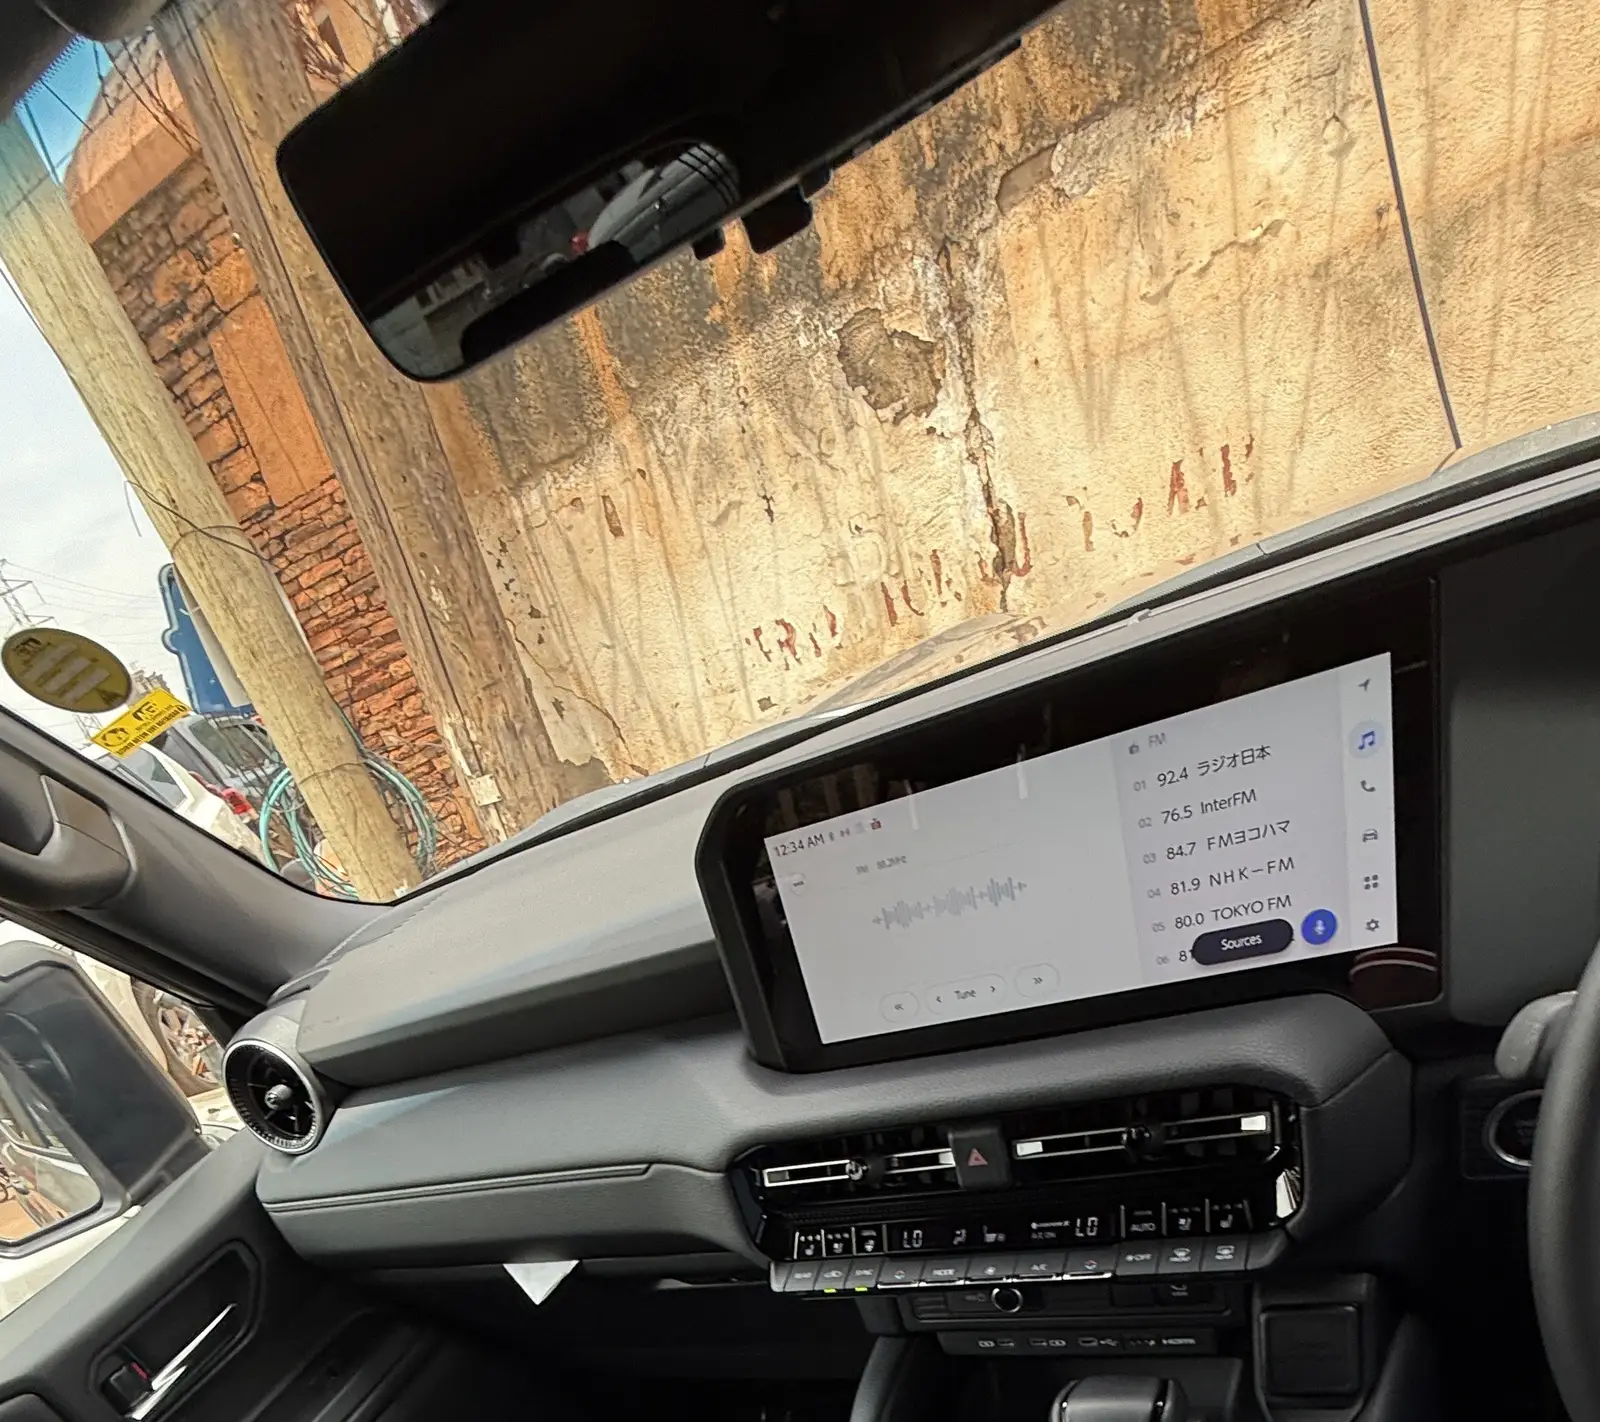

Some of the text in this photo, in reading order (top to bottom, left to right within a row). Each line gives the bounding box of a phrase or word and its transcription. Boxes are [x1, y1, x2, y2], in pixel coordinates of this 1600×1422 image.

[1148, 732, 1168, 748] FM
[1133, 744, 1273, 792] 01 92.4 ラジオ日本
[1138, 788, 1258, 829] 02 76.5 InterFM
[774, 832, 826, 858] 12:34 AM
[1142, 820, 1292, 865] 03 84.7 FMヨコハマ
[1147, 887, 1161, 900] 04
[1170, 877, 1202, 897] 81.9
[1152, 894, 1293, 934] 05 80.0 TOKYO FM
[1220, 933, 1263, 952] Sources
[953, 986, 977, 1002] Tune
[1130, 1221, 1156, 1233] AUTO
[1135, 1253, 1152, 1261] OFF
